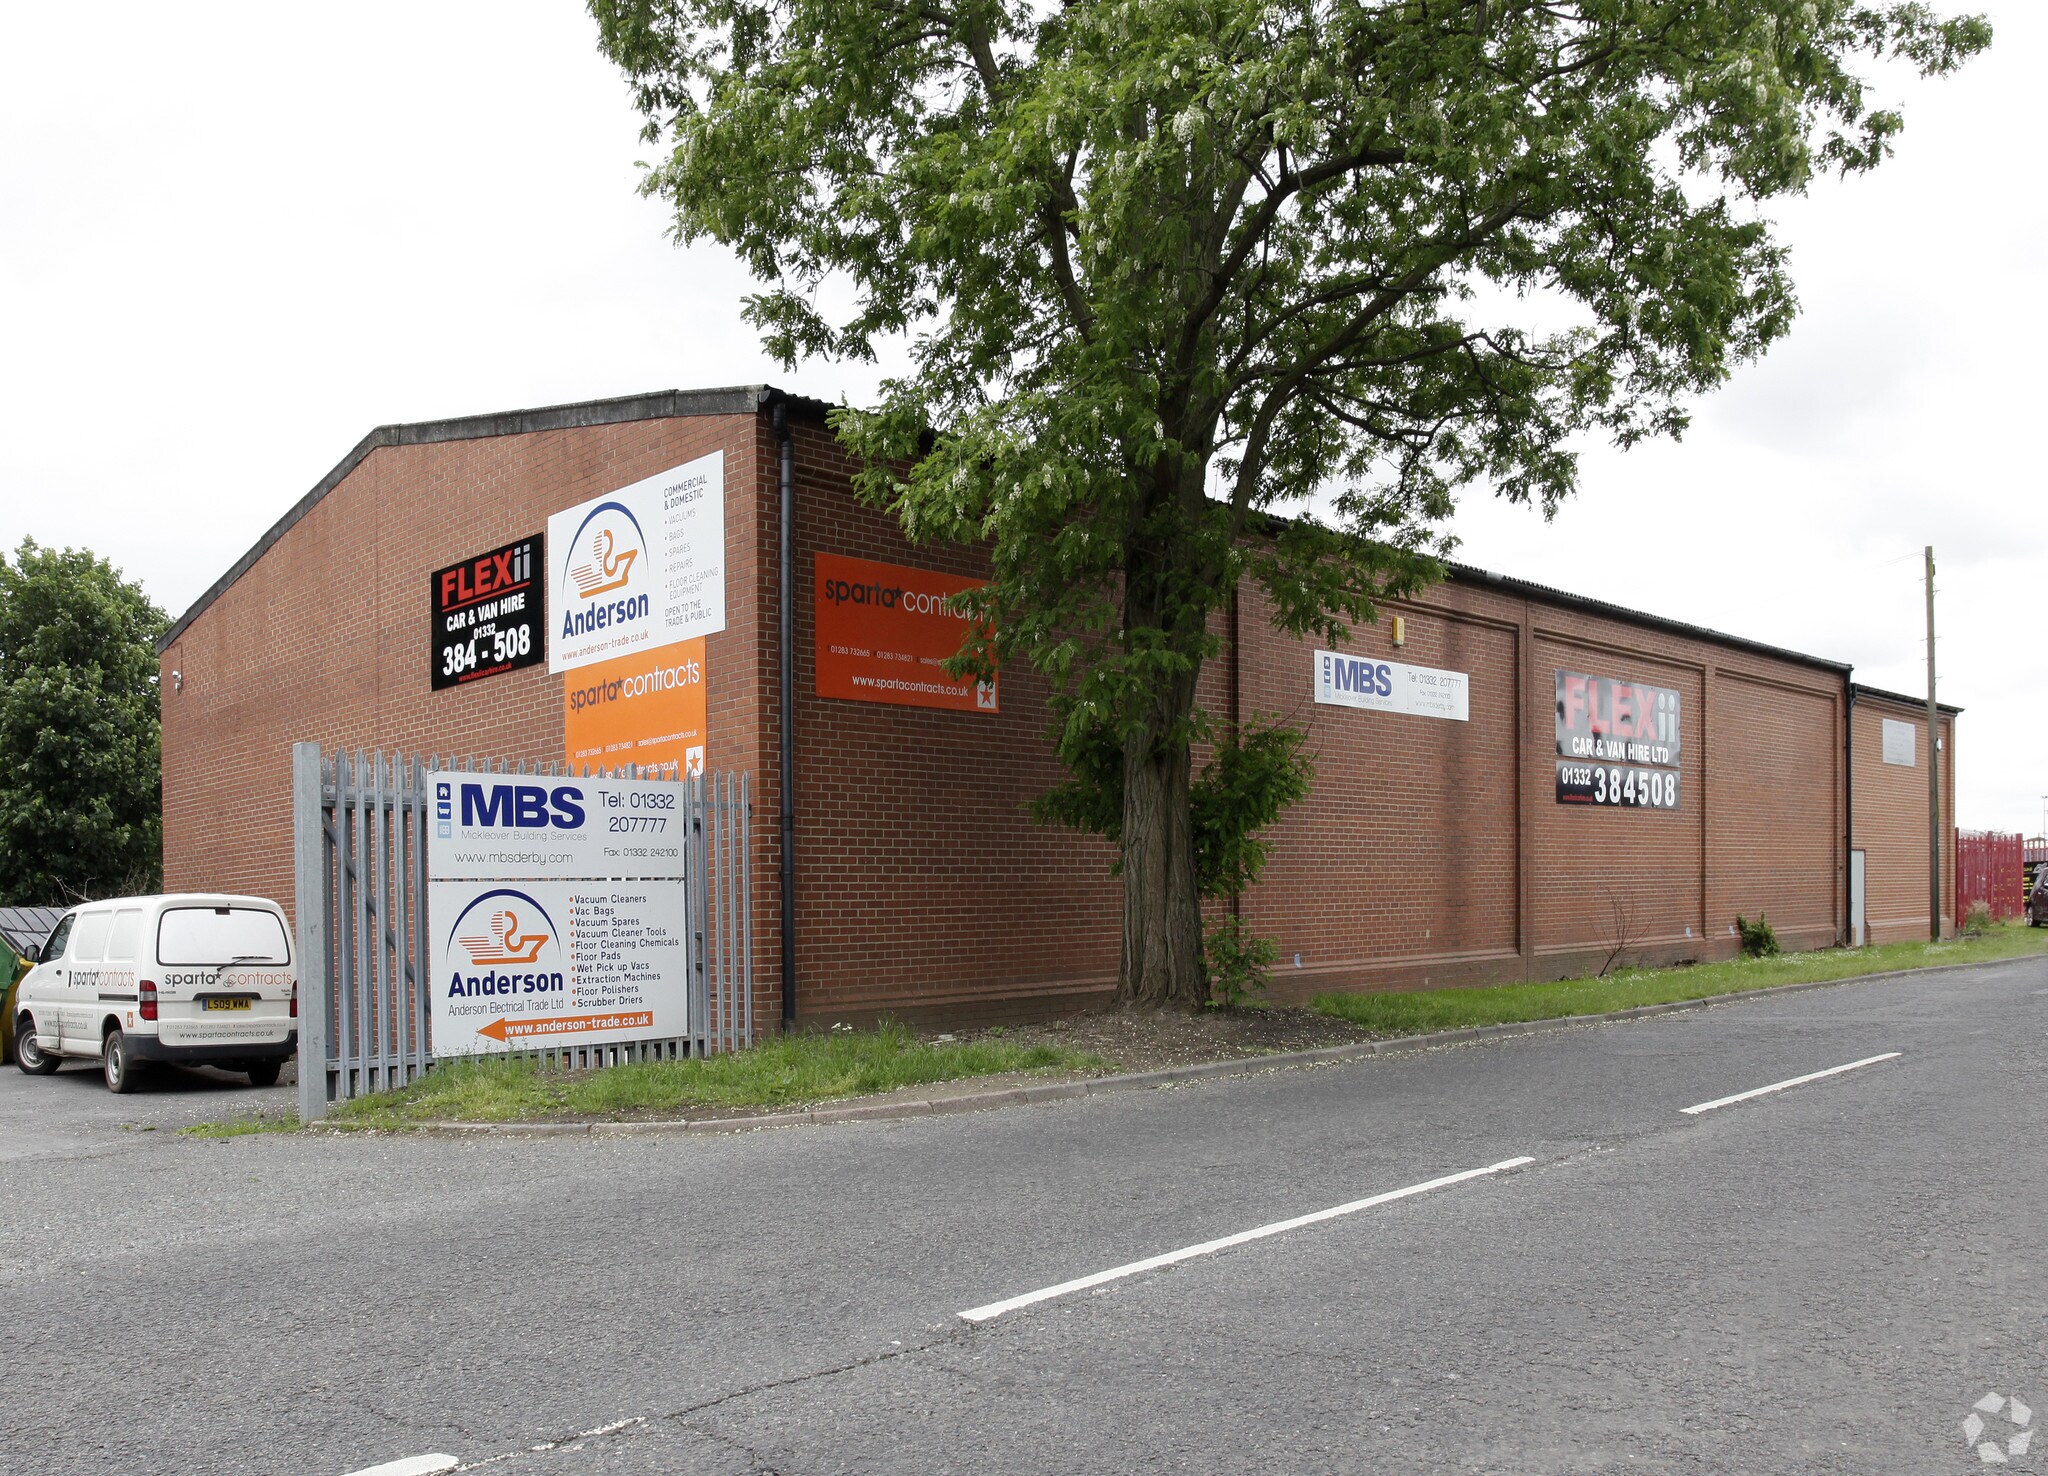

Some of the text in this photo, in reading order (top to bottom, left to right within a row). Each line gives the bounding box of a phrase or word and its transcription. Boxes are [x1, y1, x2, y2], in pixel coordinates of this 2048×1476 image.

[664, 474, 707, 498] COMMERCIAL
[664, 488, 704, 511] & DOMESTIC
[669, 508, 696, 525] VACUUMS
[669, 528, 684, 541] BAGS
[669, 542, 691, 557] SPARES
[669, 558, 693, 573] REPAIRS
[441, 543, 531, 607] FLEXii
[669, 566, 719, 590] FLOOR CLEANING
[669, 583, 703, 601] EQUIPMENT
[825, 579, 895, 608] sparta
[447, 592, 525, 632] CAR & VAN HIRE
[562, 592, 649, 640] Anderson
[664, 599, 701, 618] OPEN TO THE
[665, 607, 712, 628] TRADE & PUBLIC
[474, 623, 496, 640] 01332
[443, 639, 476, 676] 384
[494, 624, 531, 662] 508
[562, 629, 649, 661] www.anderson-trade.co.uk
[570, 658, 700, 714] sparta contracts
[852, 675, 968, 697] www.spartacontracts.co.uk
[1335, 658, 1392, 697] MBS
[1565, 676, 1676, 743] FLEXii
[1572, 736, 1669, 763] CAR & VAN HIRE LTD
[1562, 767, 1676, 807] 01332 384508
[461, 783, 586, 830] MBS
[599, 791, 675, 810] Tel: 01332
[609, 816, 668, 834] 207777
[461, 830, 588, 842] Mickleover Building Services
[454, 851, 574, 866] www.mbsderby.com
[604, 848, 679, 858] Fax: 01332 242100
[575, 894, 647, 904] Vacuum Cleaners
[575, 906, 615, 916] Vac Bags
[575, 917, 640, 927] Vacuum Spares
[575, 927, 666, 938] Vacuum Cleaner Tools
[576, 938, 679, 950] Floor Cleaning Chemicals
[576, 951, 621, 961] Floor Pads
[576, 962, 650, 973] Wet Pick up Vacs
[164, 971, 292, 987] sparta contracts
[448, 970, 564, 998] Anderson
[577, 972, 661, 985] Extraction Machines
[577, 985, 639, 996] Floor Polishers
[207, 999, 249, 1009] LS09 WMA
[448, 998, 564, 1017] Anderson Electrical Trade Ltd
[578, 996, 643, 1007] Scrubber Driers
[505, 1013, 649, 1035] www.anderson-trade.co.uk
[179, 1029, 274, 1039] www.spartacontracts.co.uk
